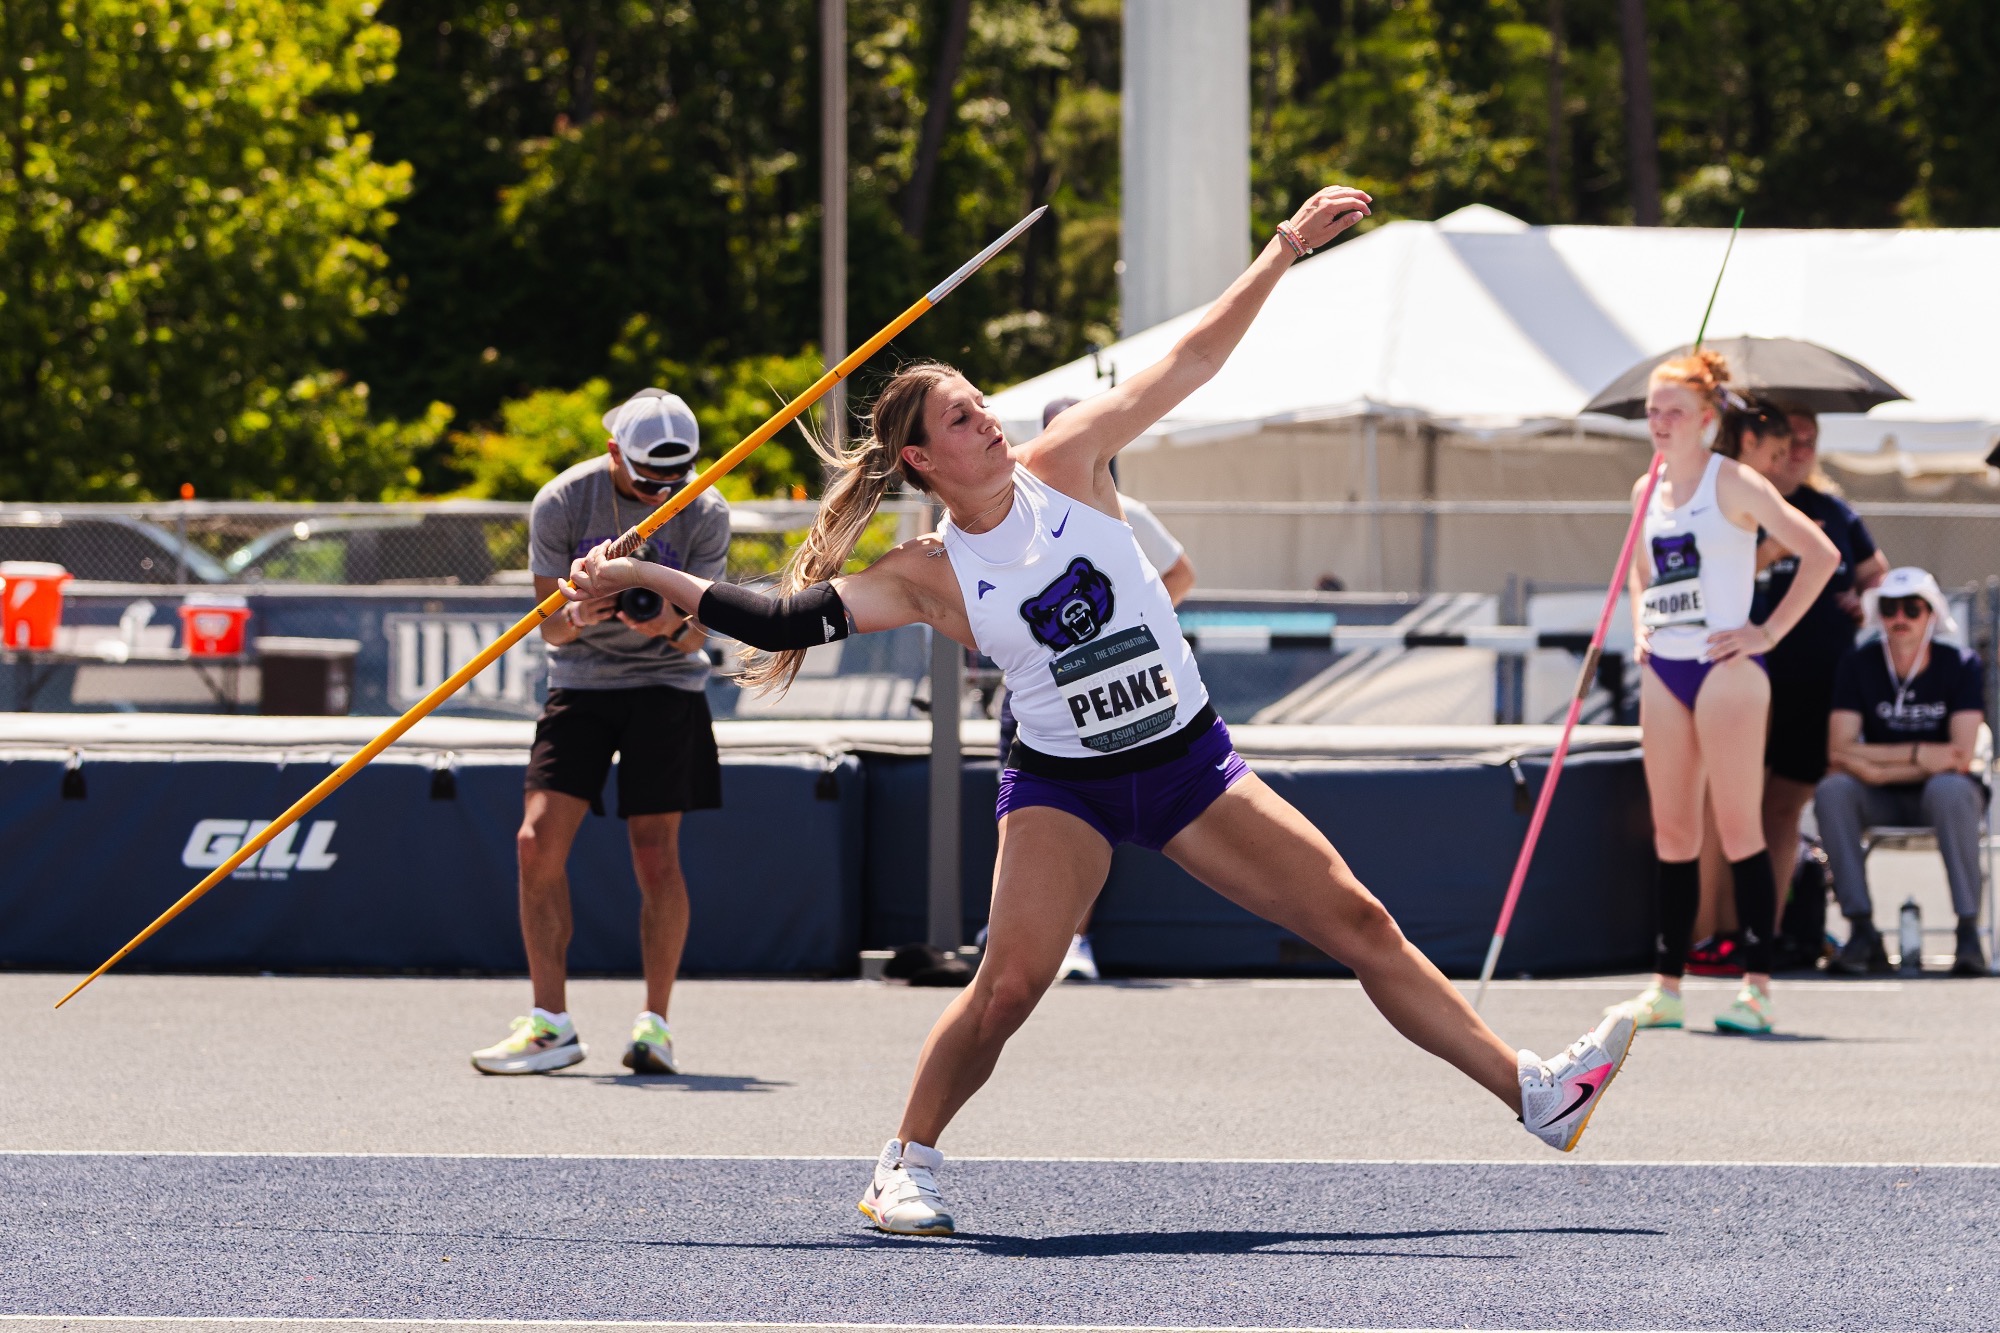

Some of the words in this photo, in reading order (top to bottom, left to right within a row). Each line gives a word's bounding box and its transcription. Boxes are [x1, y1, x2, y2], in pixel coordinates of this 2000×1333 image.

[398, 619, 546, 699] UNF
[1056, 657, 1086, 674] ASUN
[1094, 649, 1109, 661] THE
[1067, 663, 1173, 729] PEAKE
[1088, 734, 1110, 748] 2025
[1111, 726, 1136, 742] ASUN
[1136, 710, 1174, 733] OUTDOOR
[181, 818, 339, 871] GILL
